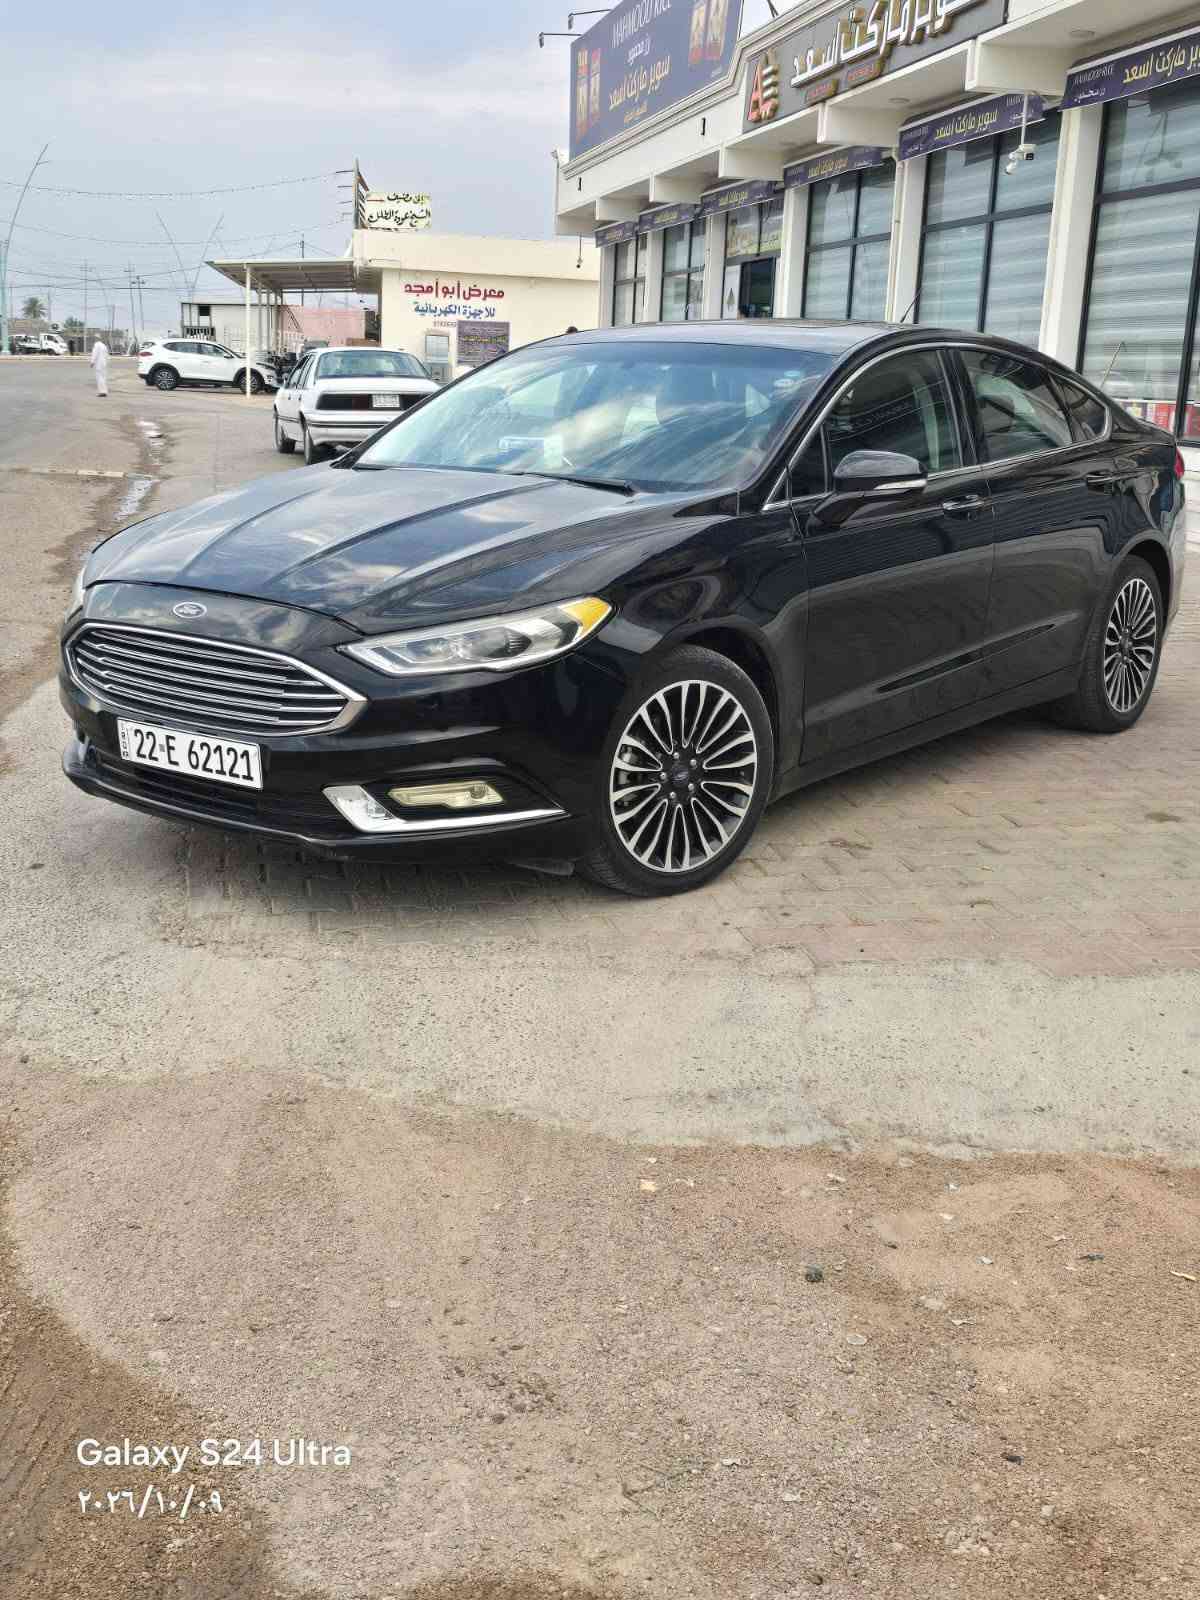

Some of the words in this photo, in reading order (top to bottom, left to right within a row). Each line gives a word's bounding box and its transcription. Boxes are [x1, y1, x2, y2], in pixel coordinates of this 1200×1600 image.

[1122, 52, 1155, 84] اسعد
[1155, 44, 1186, 77] ماركت
[462, 284, 505, 301] معرض
[134, 729, 159, 762] 22
[165, 735, 179, 766] E
[188, 740, 254, 782] 62121
